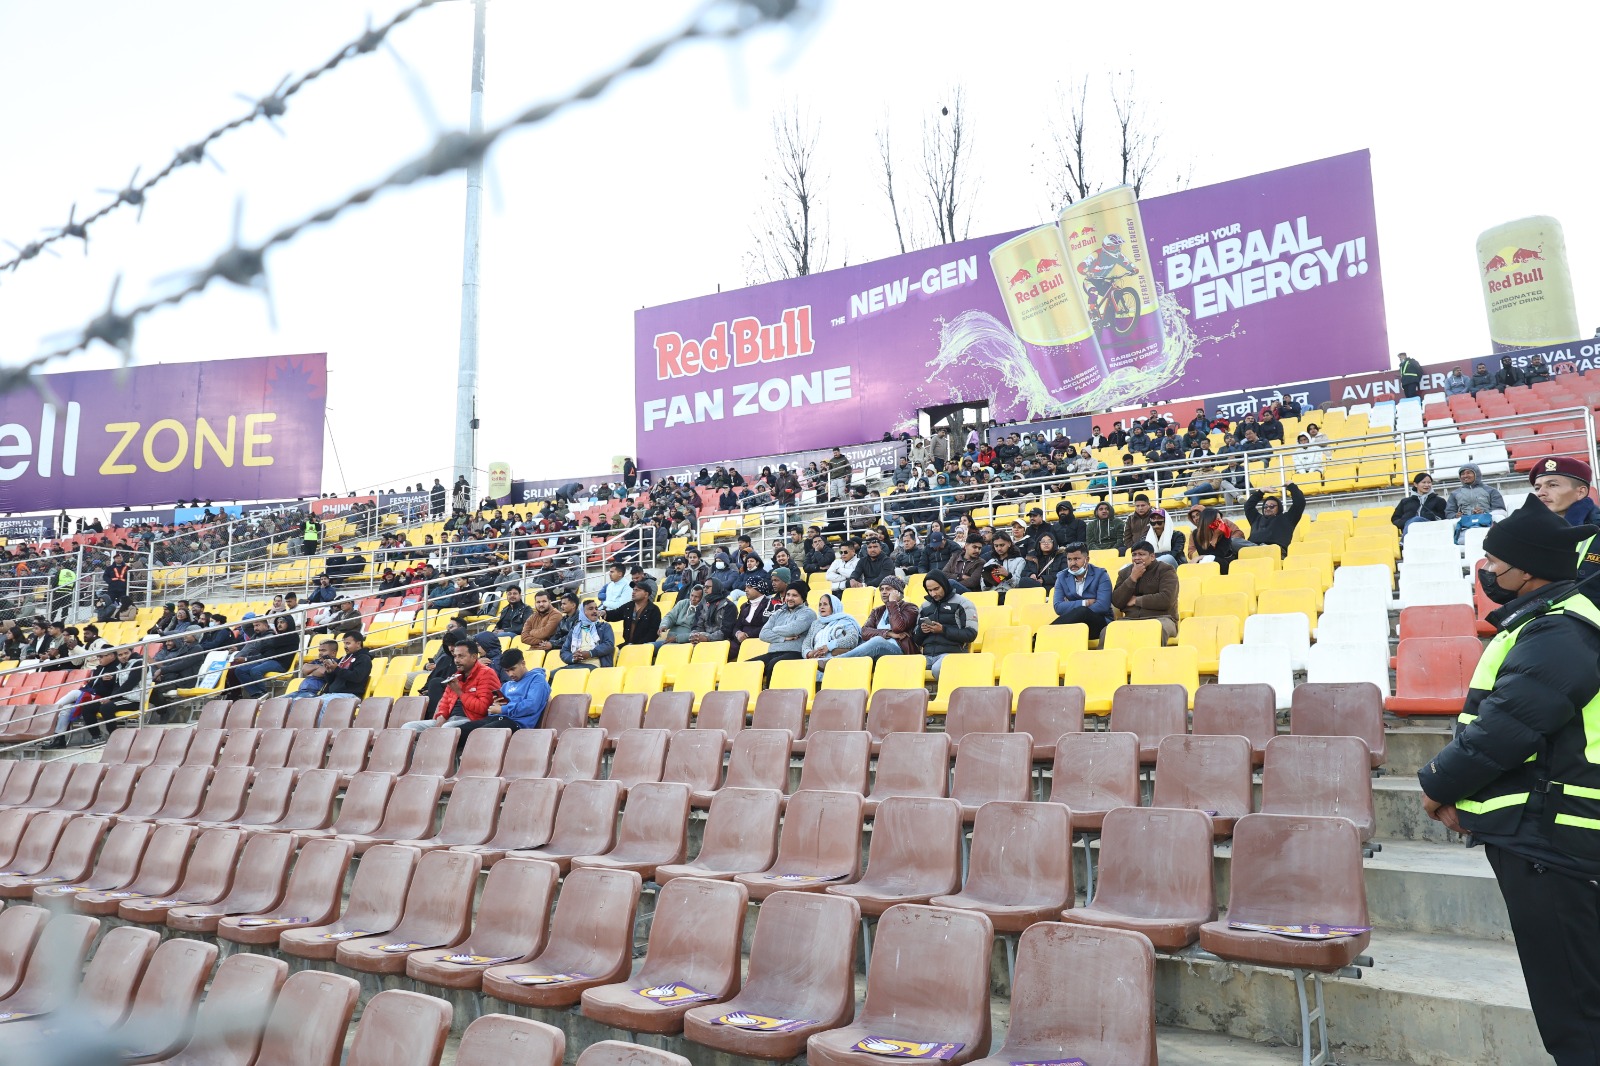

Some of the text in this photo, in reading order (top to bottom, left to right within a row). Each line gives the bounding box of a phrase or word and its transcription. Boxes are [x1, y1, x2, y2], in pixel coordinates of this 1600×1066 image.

[1070, 235, 1097, 252] Red Bull
[1162, 222, 1242, 257] REFRESH YOUR
[1166, 215, 1323, 291] BABAAL
[1126, 217, 1150, 305] REFRESH YOUR ENERGY
[830, 254, 978, 327] THE NEW-GEN
[1014, 272, 1065, 304] Red Bull
[1193, 236, 1369, 320] ENERGY!!
[1488, 267, 1544, 294] Red Bull
[1491, 289, 1543, 308] CARBONATED
[1518, 295, 1545, 306] DRINK
[653, 304, 816, 381] Red Bull
[1110, 342, 1158, 363] CARBONATED
[1108, 348, 1159, 369] ENERGY DRINK
[1062, 365, 1098, 385] BLUEBERRY
[1074, 374, 1102, 392] FLAVOUR
[1341, 370, 1454, 400] AVENER
[643, 365, 852, 432] FAN ZONE
[99, 412, 277, 476] ZONE
